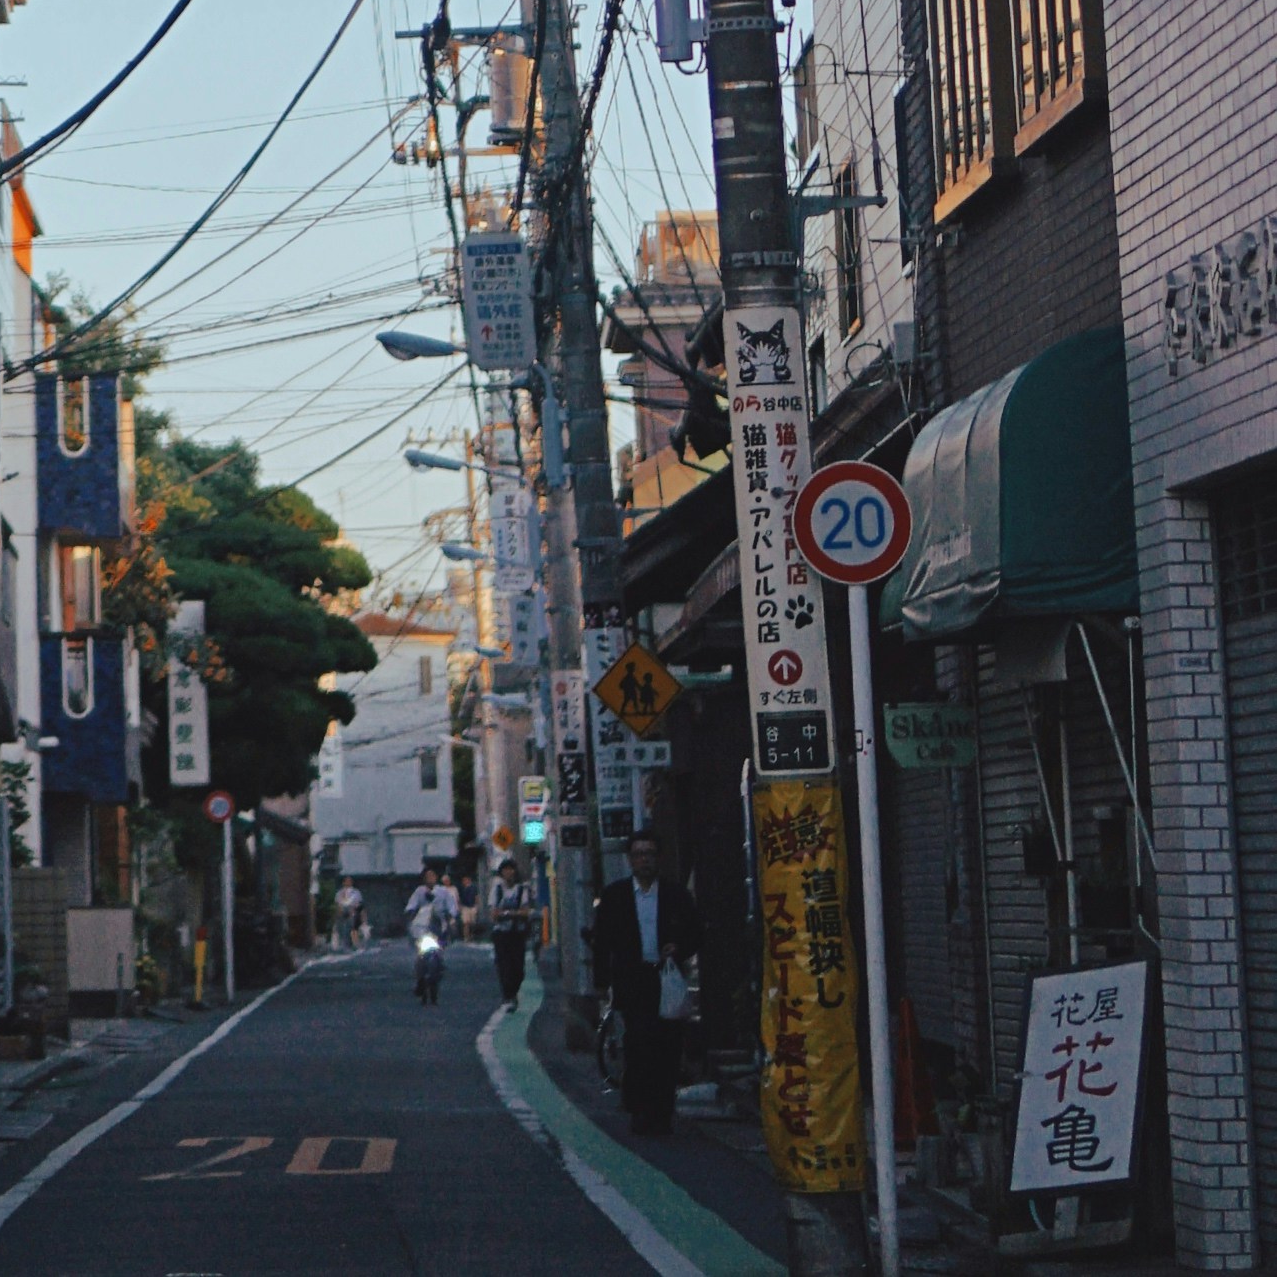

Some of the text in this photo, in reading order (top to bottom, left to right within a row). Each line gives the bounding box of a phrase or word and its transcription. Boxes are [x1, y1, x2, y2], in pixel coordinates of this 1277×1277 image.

[732, 395, 803, 414] のら谷中店
[742, 423, 781, 644] 猫雑貨・アパレルの店
[820, 496, 886, 550] 20
[759, 688, 818, 706] すぐ左側
[766, 724, 817, 743] 谷中
[767, 747, 815, 764] 5-11
[762, 810, 823, 867] 注意
[801, 867, 846, 1009] 道幅狭し
[764, 892, 813, 1137] スピード落とせ
[1050, 986, 1124, 1029] 花屋
[1040, 1030, 1118, 1173] 花亀
[138, 1135, 399, 1182] 20
